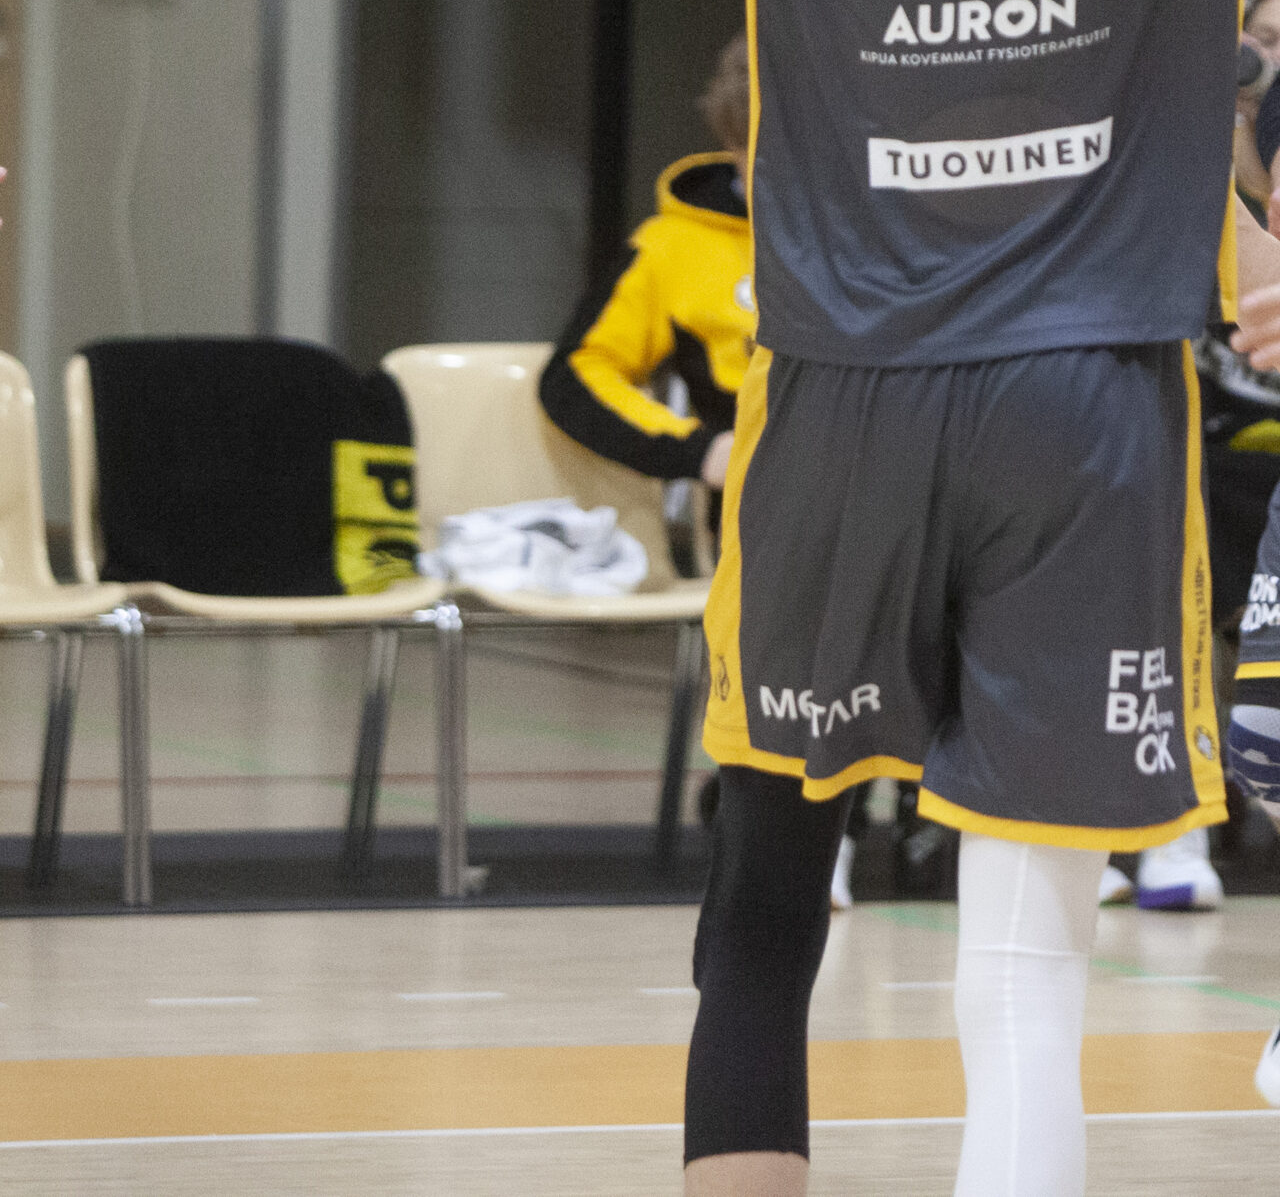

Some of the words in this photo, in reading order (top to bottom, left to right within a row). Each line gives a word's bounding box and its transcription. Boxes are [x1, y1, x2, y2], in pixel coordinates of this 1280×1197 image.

[860, 49, 898, 65] KIPUA
[901, 49, 983, 67] KOVEMMAT
[987, 26, 1111, 61] FYSIOTERAPEUTIT
[887, 133, 1102, 179] TUOVINEN
